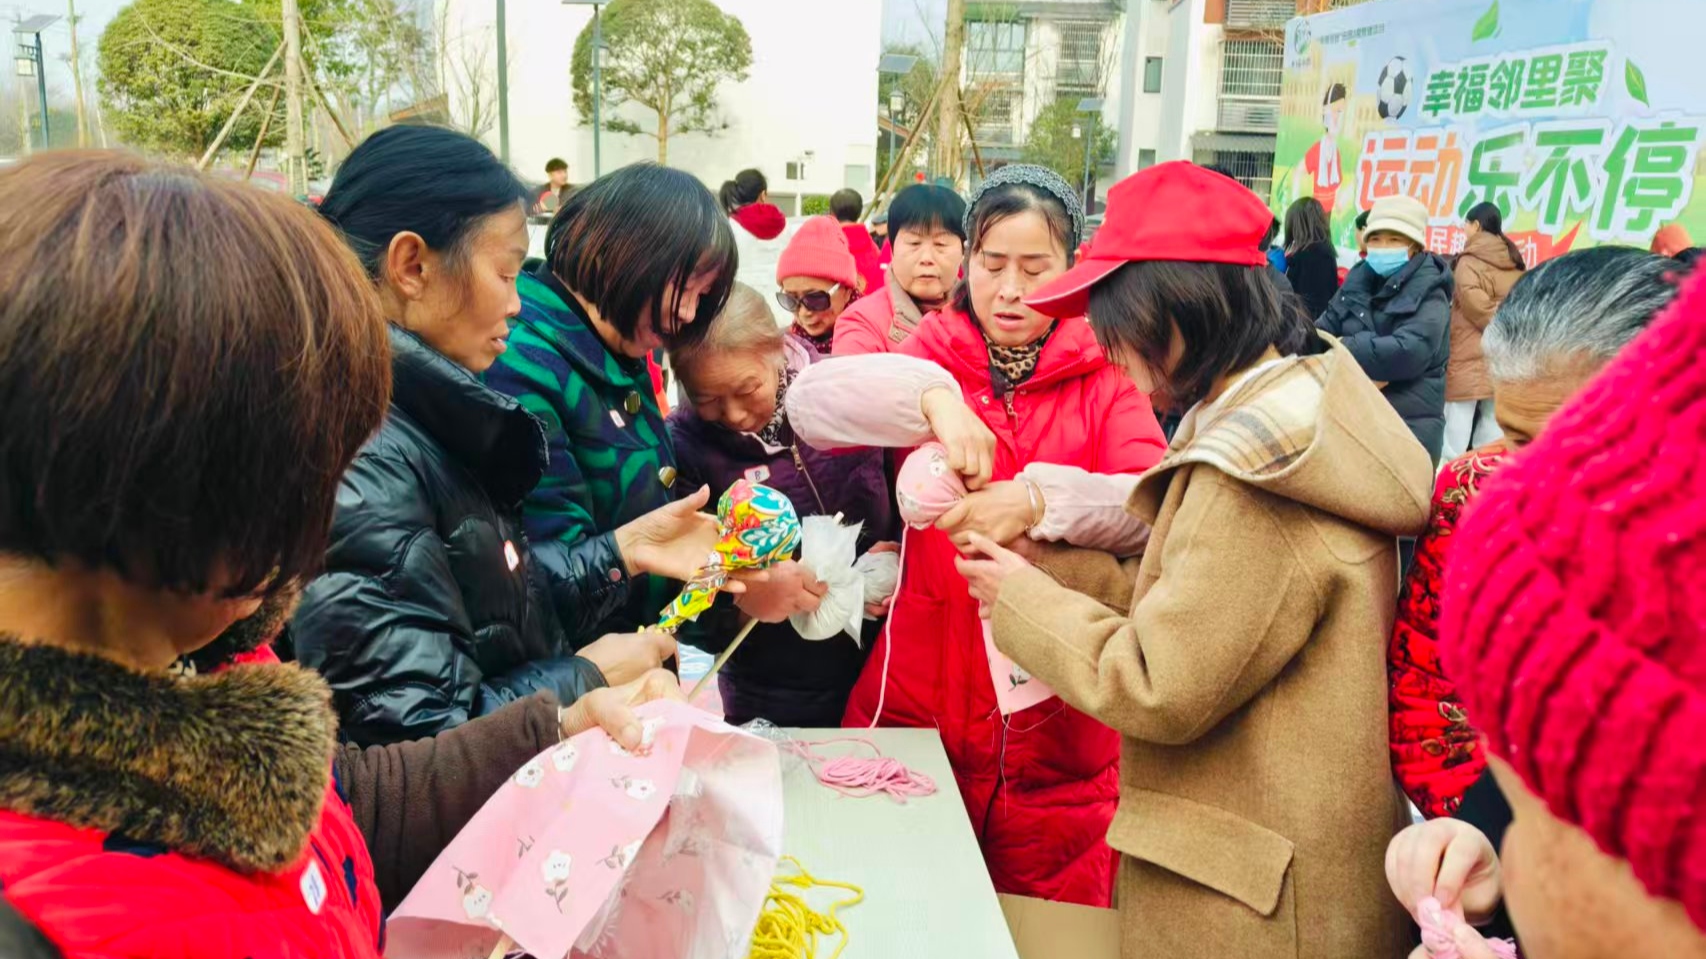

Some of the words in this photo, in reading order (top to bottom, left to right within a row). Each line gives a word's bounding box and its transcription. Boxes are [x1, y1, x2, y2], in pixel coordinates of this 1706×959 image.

[1422, 49, 1608, 117] 幸福邻里聚
[1359, 121, 1698, 232] 运动乐不停
